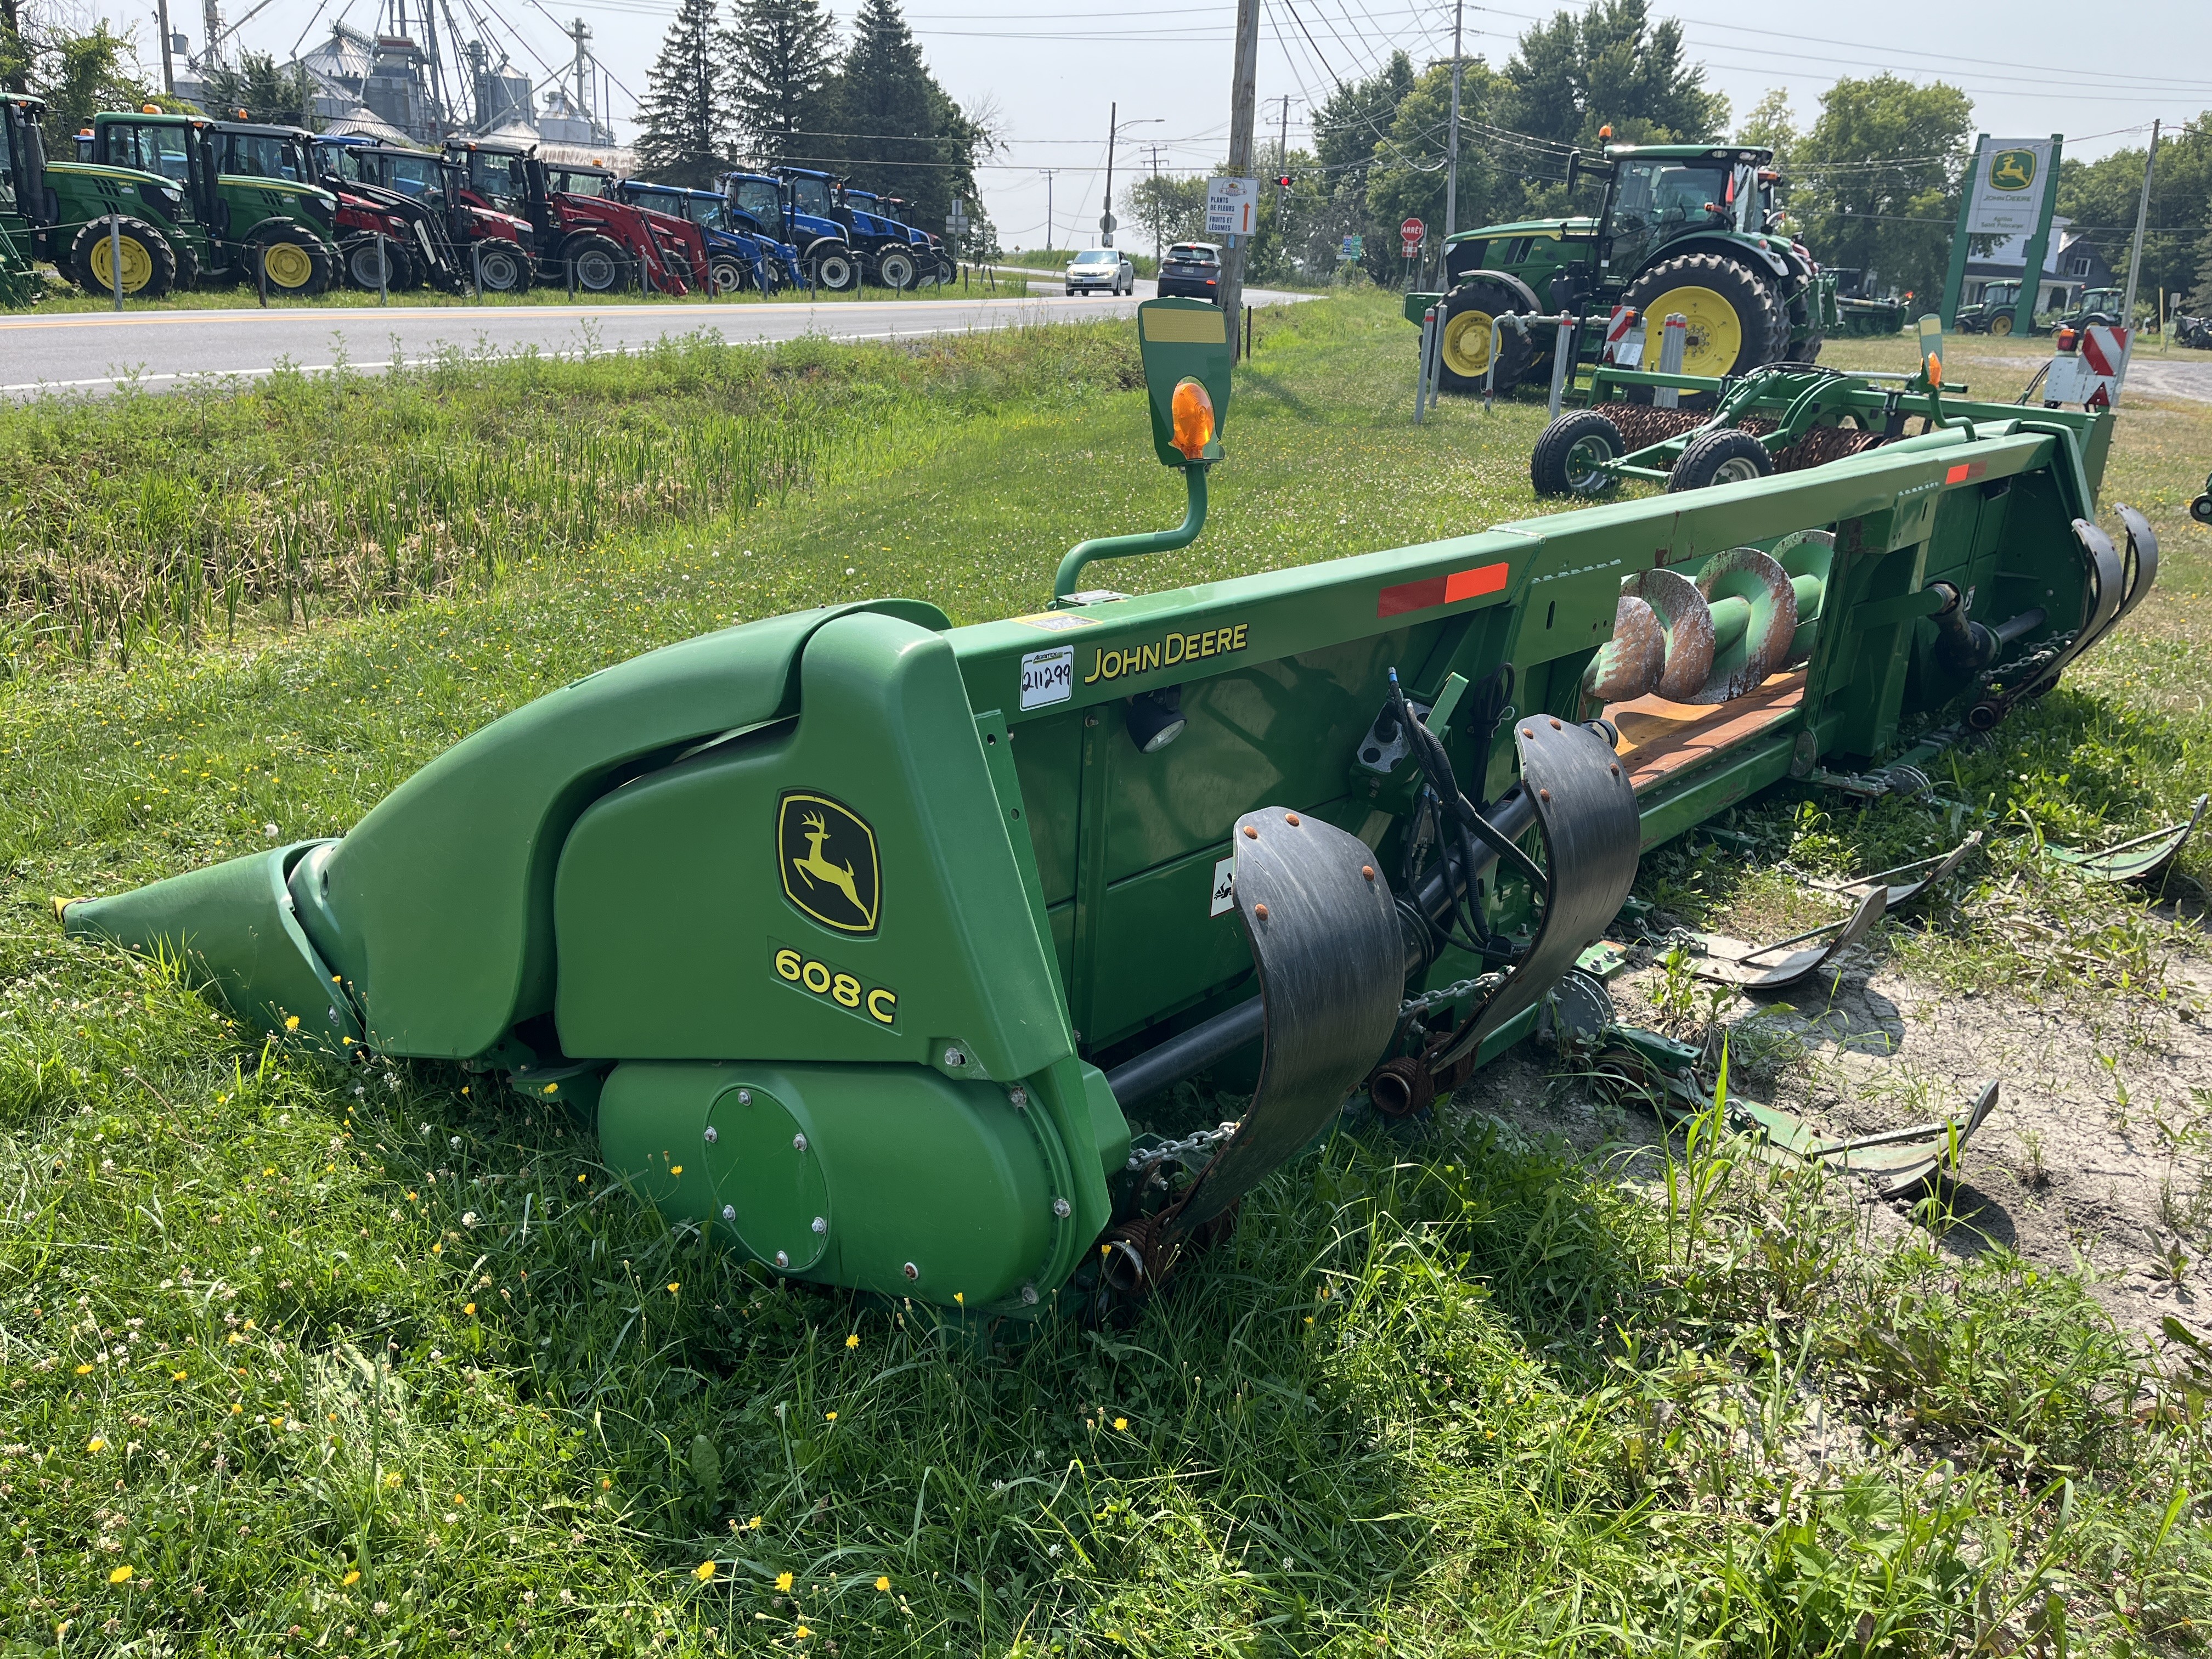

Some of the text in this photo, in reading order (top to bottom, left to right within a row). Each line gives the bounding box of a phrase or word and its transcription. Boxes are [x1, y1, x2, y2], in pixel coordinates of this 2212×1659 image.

[1209, 222, 1231, 231] LÉGUMES
[1402, 226, 1422, 234] ARRÊT
[1034, 652, 1057, 661] AGRITEX
[1084, 623, 1248, 684] JOHN DEERE
[1022, 664, 1070, 692] 211299
